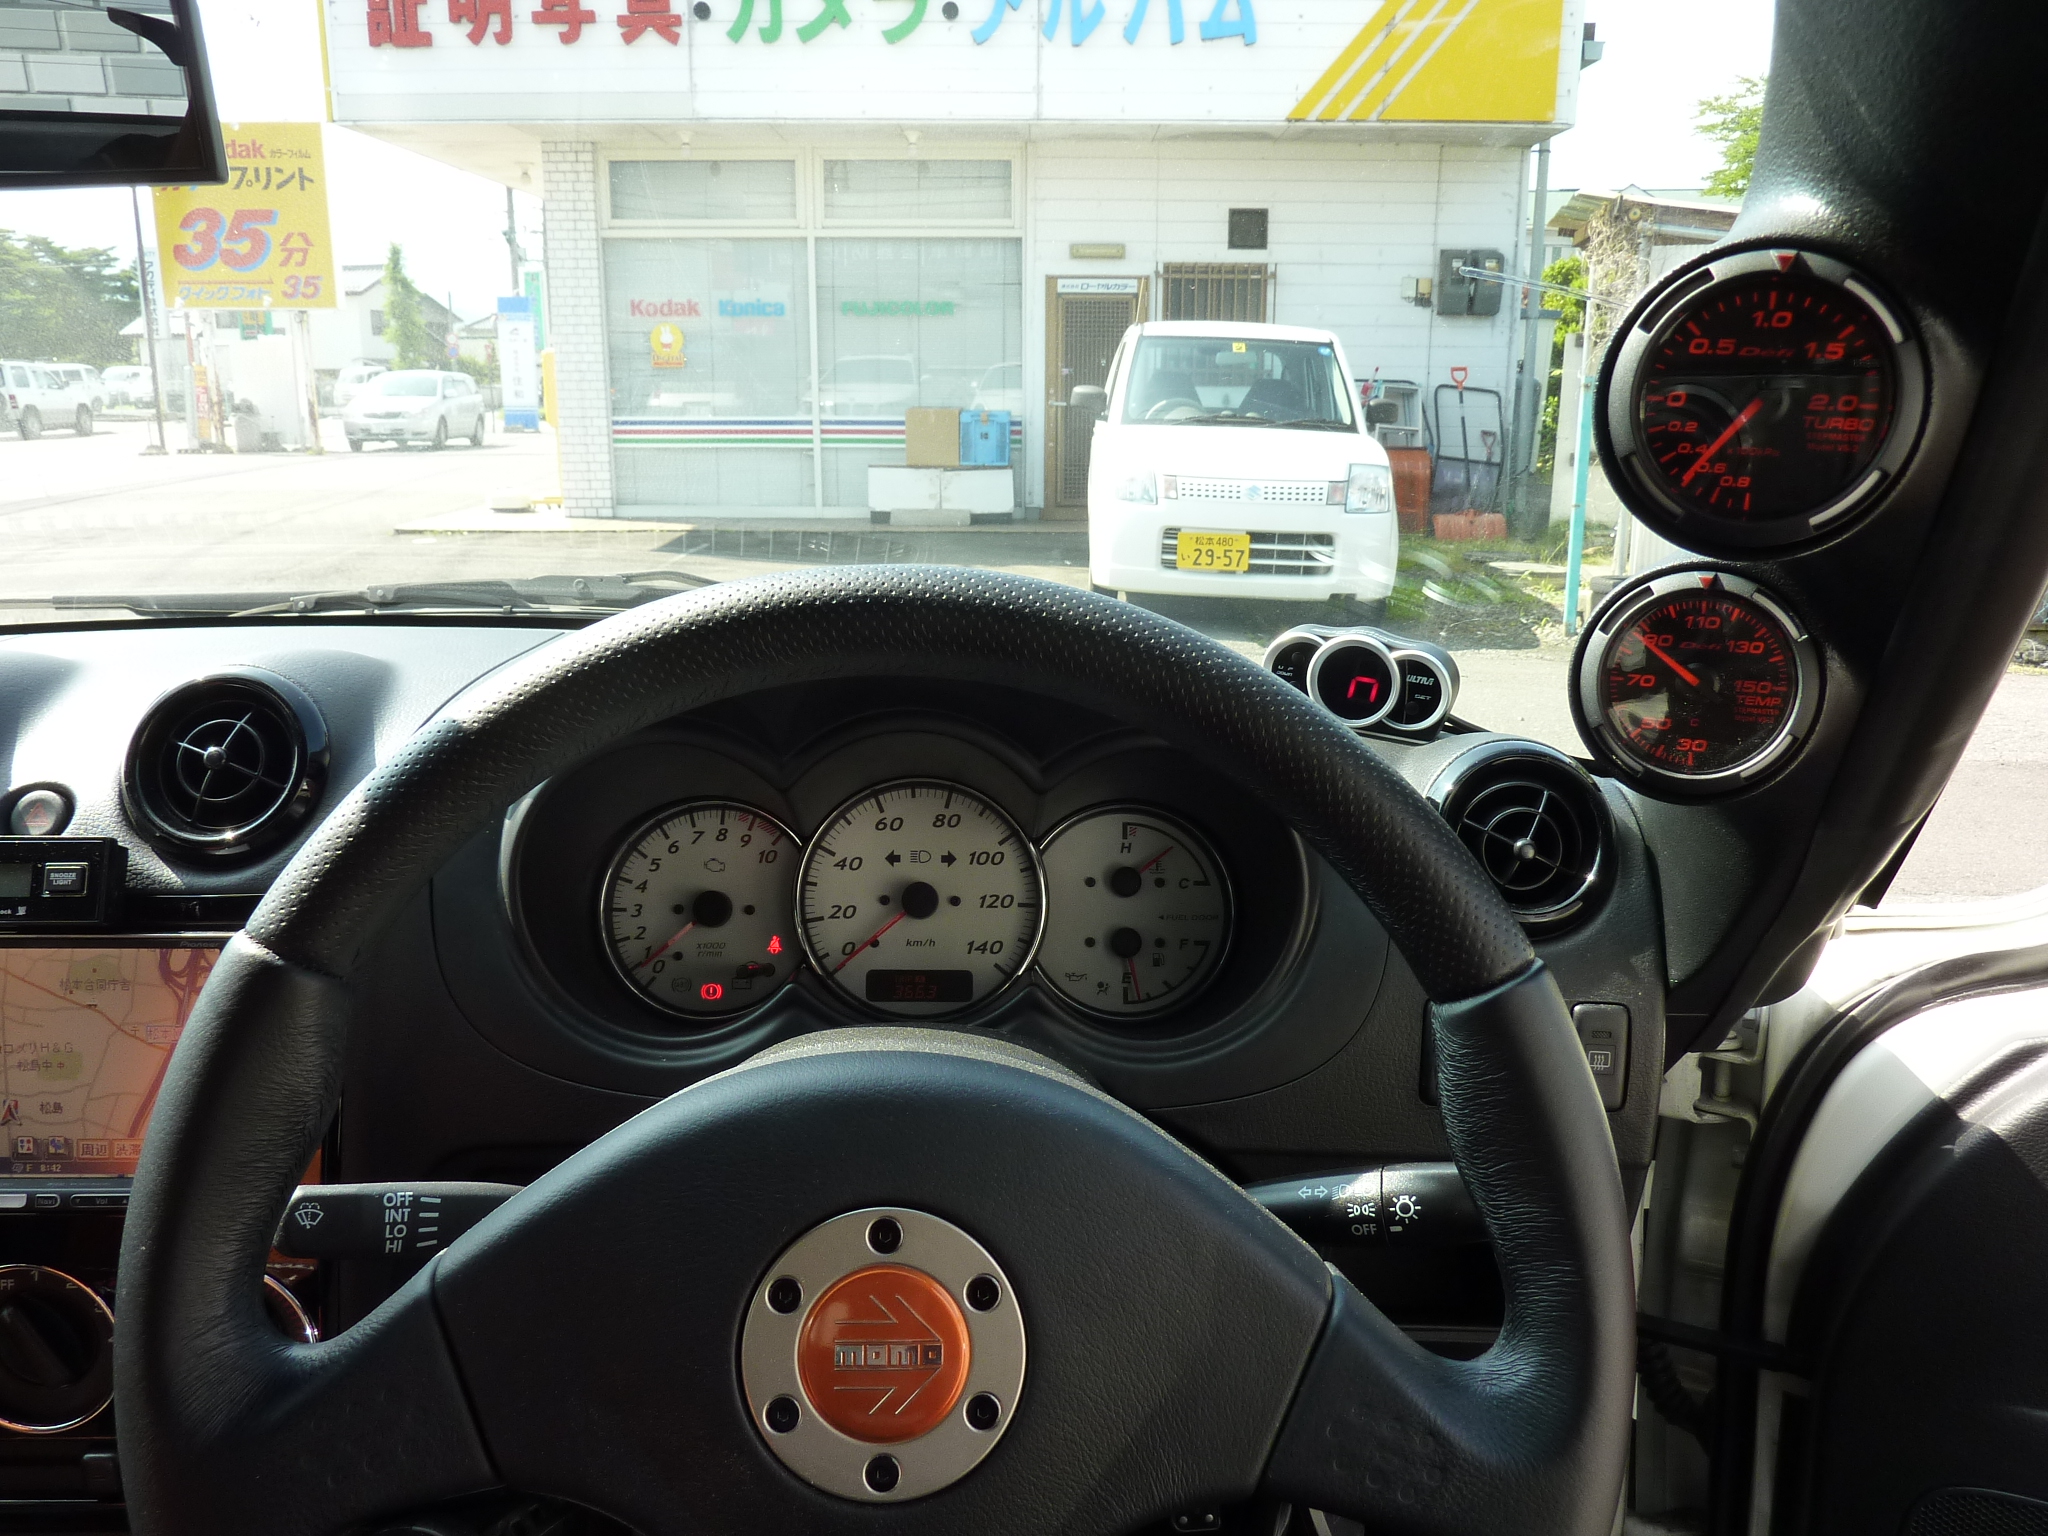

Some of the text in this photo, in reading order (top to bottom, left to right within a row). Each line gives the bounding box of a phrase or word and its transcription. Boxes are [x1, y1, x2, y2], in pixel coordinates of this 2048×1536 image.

[226, 139, 266, 159] dak
[173, 207, 315, 273] 35 分
[281, 274, 324, 300] 35
[630, 299, 701, 317] Kodak
[718, 299, 785, 317] Konica
[1752, 311, 1793, 328] 1.0
[1688, 338, 1736, 355] 0.5
[1804, 342, 1846, 359] 1.5
[1807, 394, 1858, 412] 2.0
[1667, 421, 1698, 433] 0.2
[1803, 416, 1875, 432] TURBO
[1696, 462, 1727, 474] 0.6
[1719, 476, 1750, 488] 0.8
[1216, 536, 1234, 547] 480
[1181, 548, 1246, 568] い 29-57
[1684, 615, 1721, 630] 110
[1726, 639, 1765, 655] 130
[1406, 674, 1435, 686] ULTRA
[1626, 674, 1656, 687] 70
[1734, 680, 1774, 694] 150
[1641, 717, 1673, 730] 50
[1676, 738, 1708, 752] 30
[874, 817, 904, 832] 60
[932, 813, 961, 829] 80
[691, 831, 704, 844] 7
[715, 828, 728, 841] 8
[740, 834, 752, 848] 9
[668, 840, 680, 854] 6
[1120, 842, 1132, 854] H
[758, 849, 778, 864] 10
[833, 856, 863, 871] 40
[968, 851, 1005, 866] 100
[648, 858, 662, 872] 5
[635, 879, 648, 893] 4
[1178, 878, 1190, 889] C
[979, 894, 1015, 909] 120
[630, 904, 643, 917] 3
[828, 904, 857, 920] 20
[634, 927, 647, 940] 2
[841, 941, 856, 956] 0
[905, 938, 936, 949] km/h
[967, 940, 1004, 956] 140
[1179, 938, 1189, 950] F
[652, 960, 665, 974] 0
[1121, 972, 1132, 984] E
[39, 1101, 63, 1115] 松島
[80, 1143, 108, 1157] 周辺
[40, 1164, 62, 1172] 8:42
[95, 1197, 109, 1205] Vol
[383, 1191, 414, 1207] OFF
[384, 1208, 411, 1223] INT
[385, 1224, 407, 1238] LO
[1351, 1223, 1378, 1236] OFF
[385, 1239, 403, 1254] HI
[0, 1278, 15, 1291] FF
[835, 1344, 943, 1367] momo
